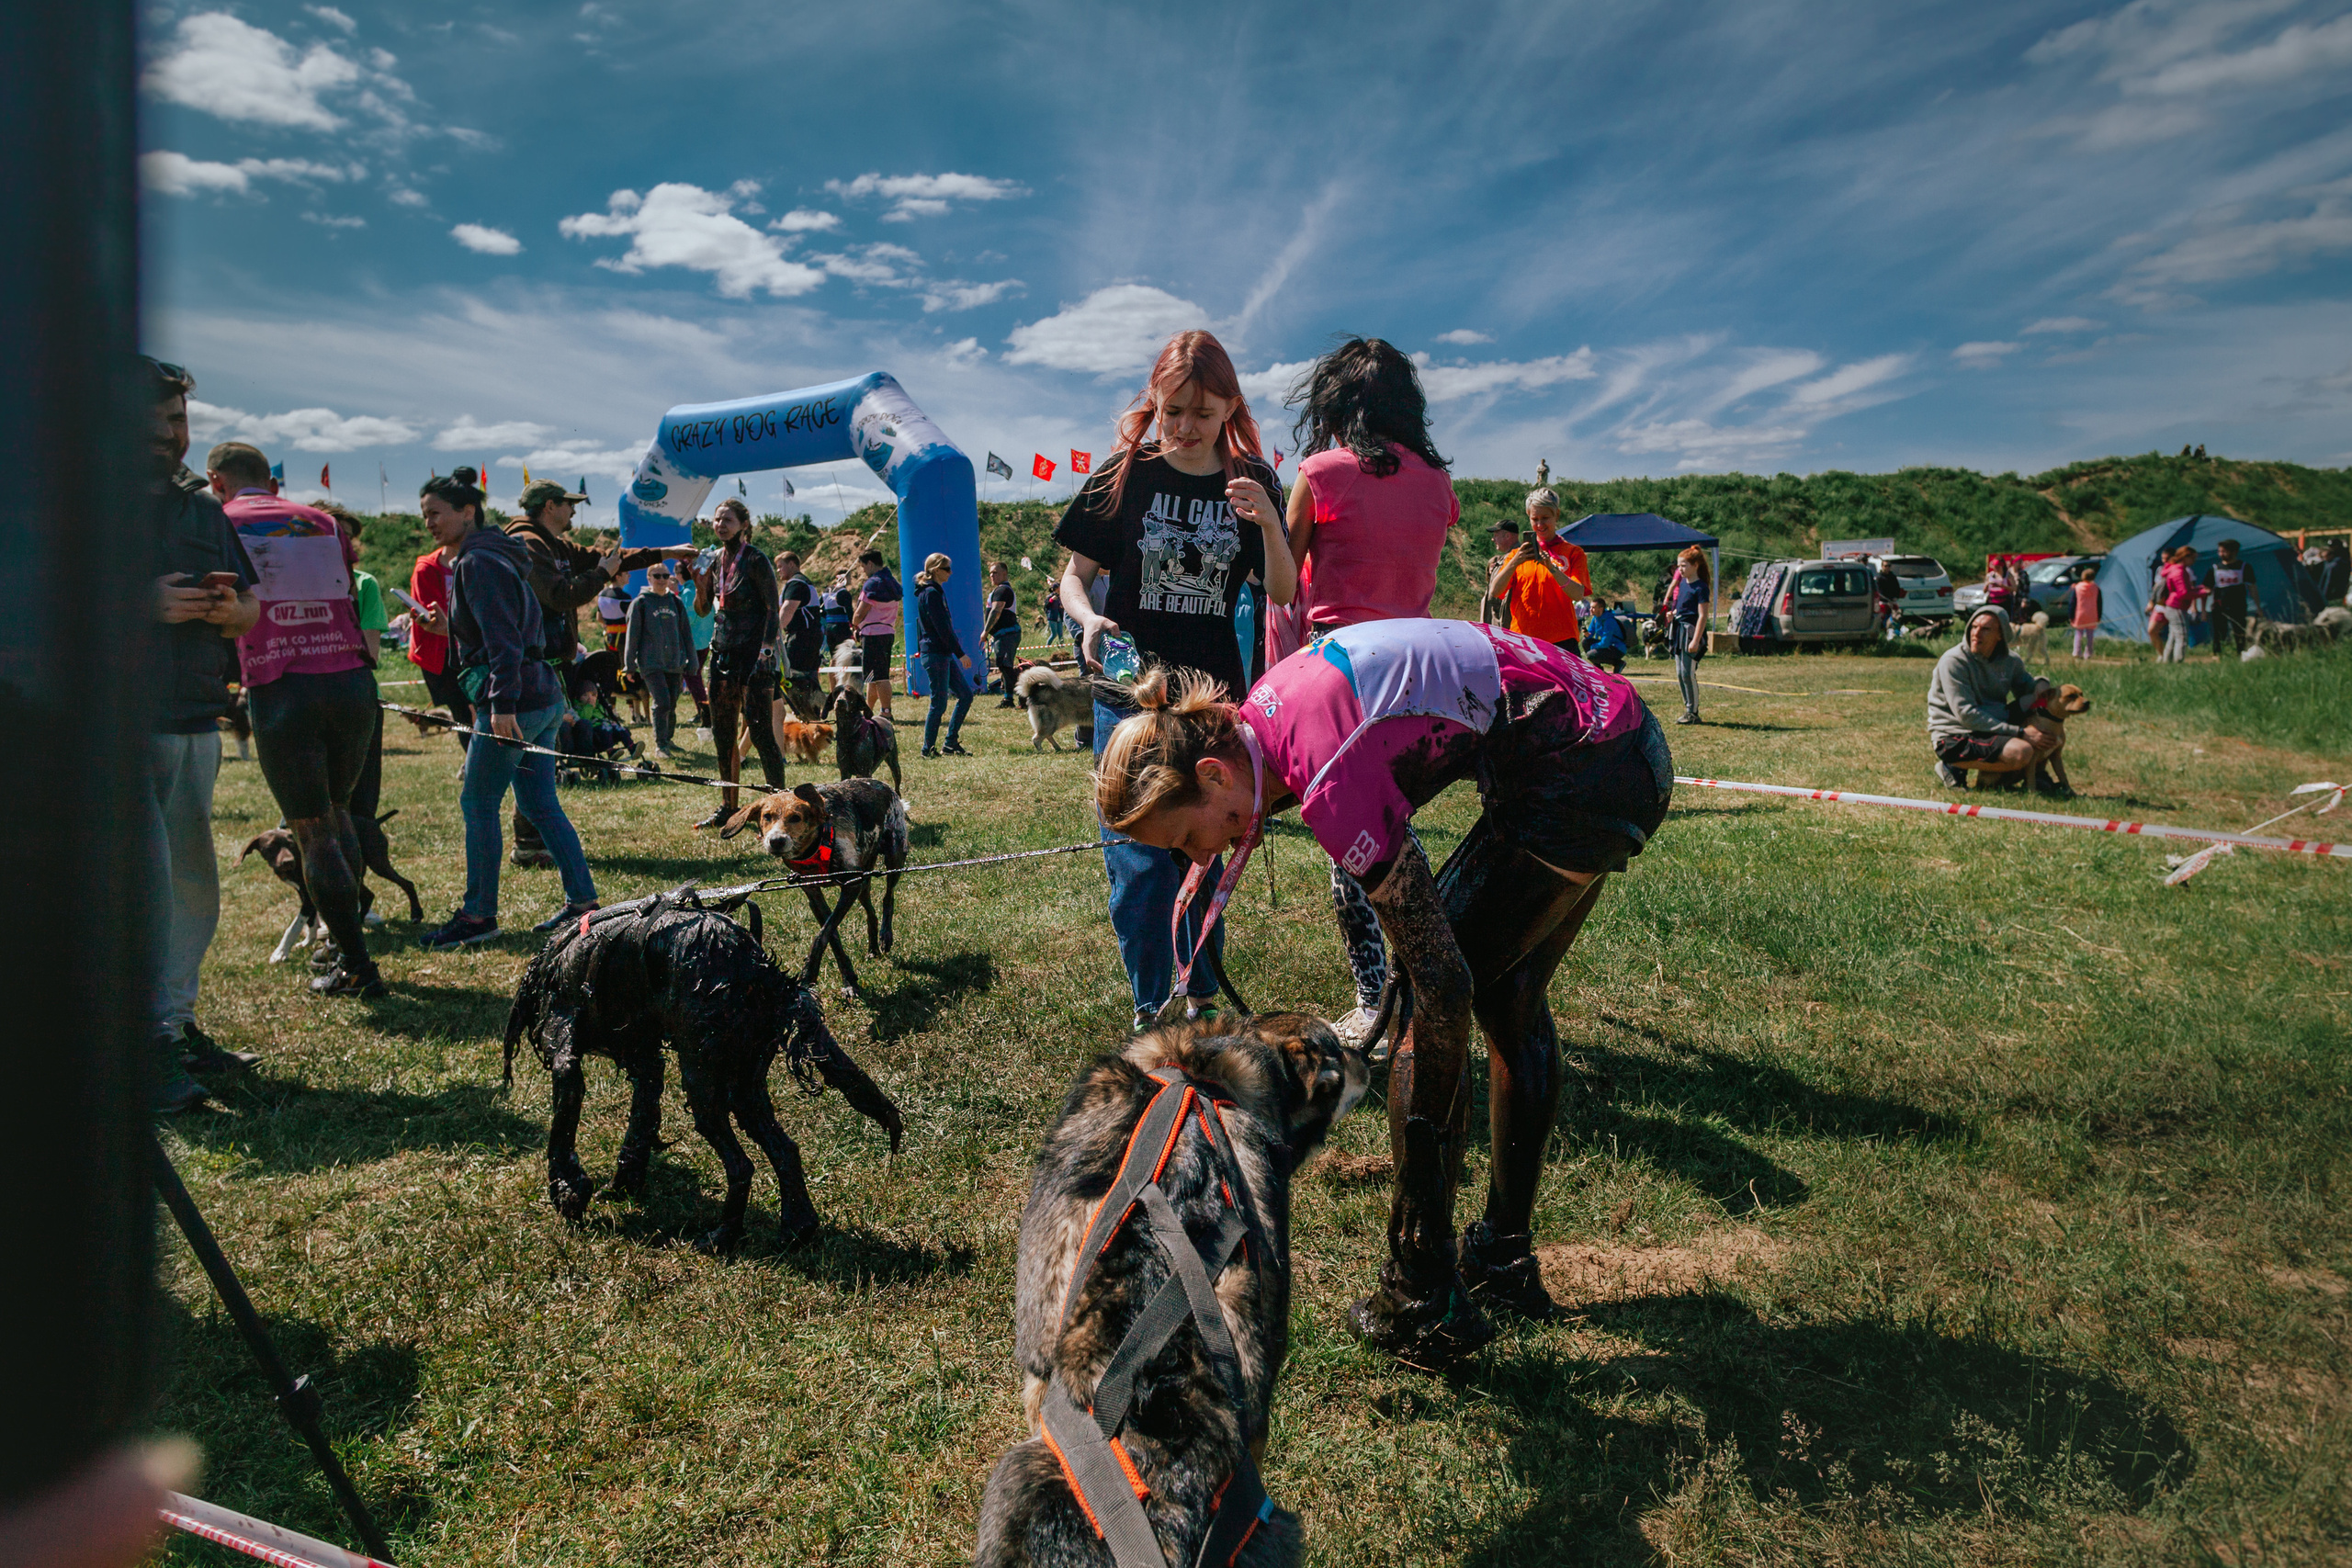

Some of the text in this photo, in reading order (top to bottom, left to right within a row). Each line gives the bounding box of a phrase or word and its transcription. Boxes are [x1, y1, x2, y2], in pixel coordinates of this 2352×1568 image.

[671, 397, 840, 452] CRAZY DOG RACE
[1150, 492, 1238, 525] ALL CATS
[1139, 593, 1227, 617] ARE BEAUTIFUL
[1225, 818, 1259, 887] CRAZY DOG RACE
